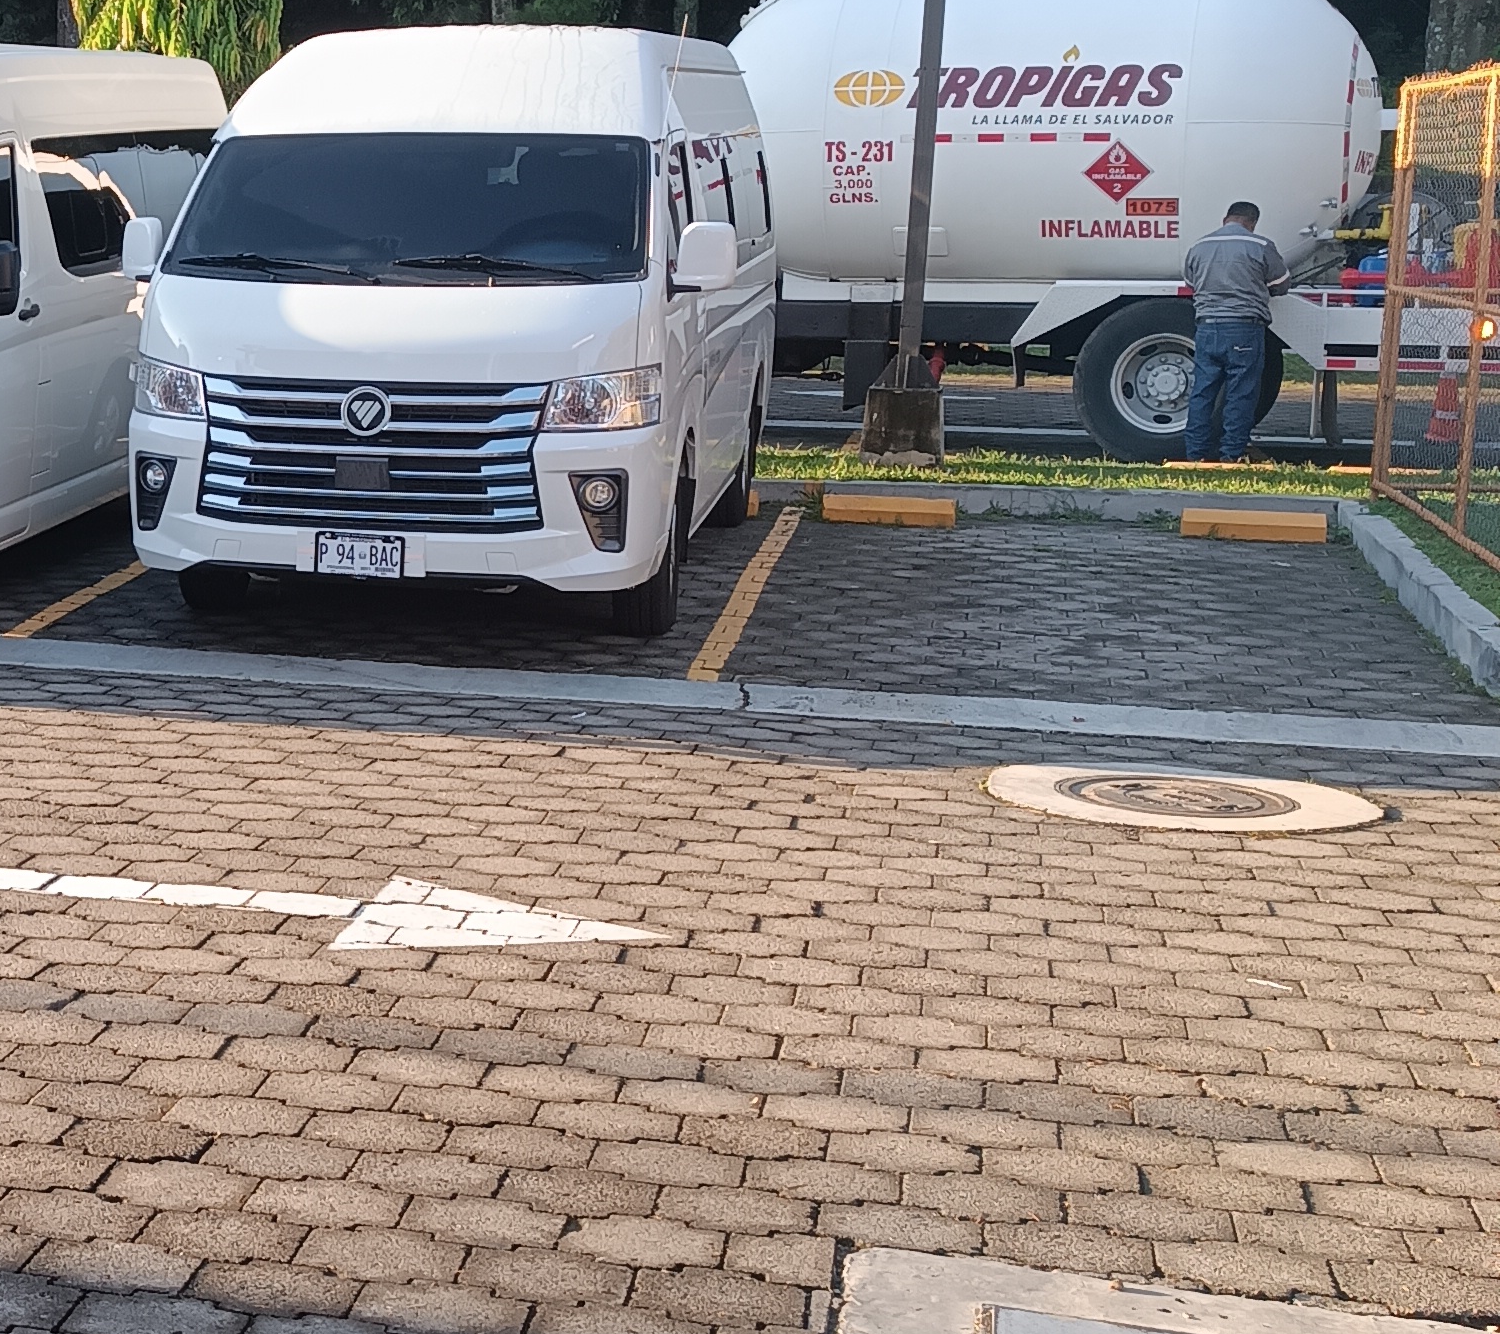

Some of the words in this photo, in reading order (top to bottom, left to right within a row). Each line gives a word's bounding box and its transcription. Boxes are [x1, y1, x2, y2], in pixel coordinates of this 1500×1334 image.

[971, 114, 989, 125] LA
[994, 114, 1043, 125] LLAMA
[1048, 114, 1067, 125] DE
[1072, 114, 1088, 125] EL
[1093, 113, 1175, 125] SALVADOR
[825, 141, 846, 162] TS
[862, 141, 893, 162] 231
[832, 164, 871, 176] CAP.
[834, 178, 873, 192] 3,000
[1112, 183, 1122, 193] 2
[829, 192, 879, 204] GLNS.
[1129, 201, 1176, 213] 1075
[1041, 219, 1180, 239] INFLAMABLE
[320, 543, 328, 563] P
[337, 544, 355, 564] 94
[369, 544, 399, 567] BAC
